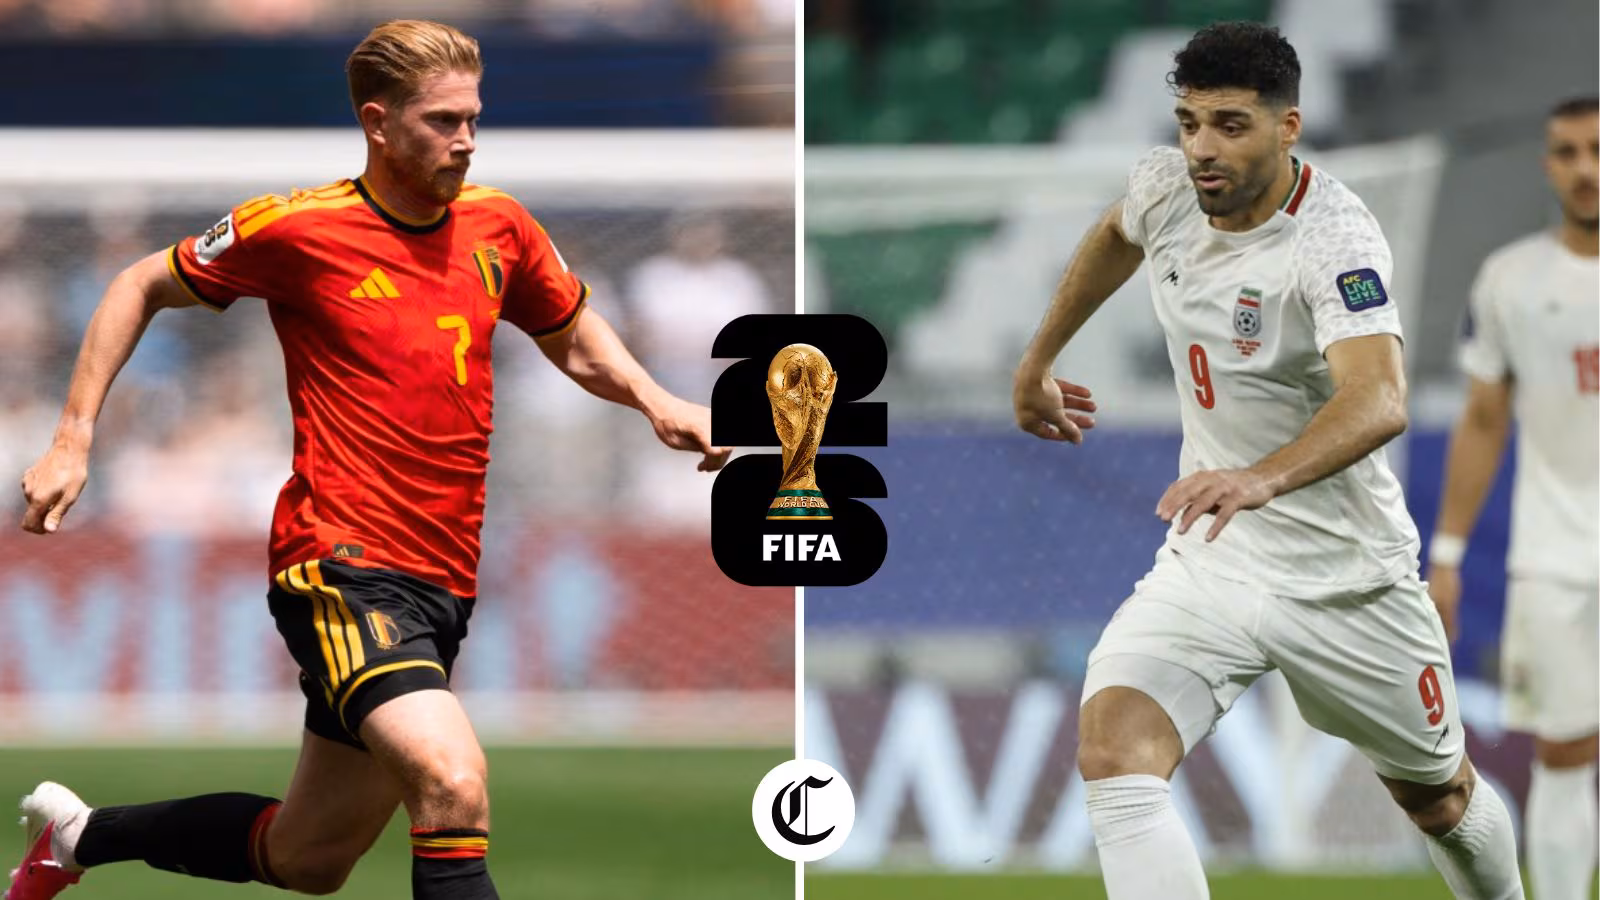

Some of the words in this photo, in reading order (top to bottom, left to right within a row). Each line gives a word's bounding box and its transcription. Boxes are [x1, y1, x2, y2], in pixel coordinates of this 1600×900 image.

[1343, 275, 1361, 286] AFC
[1345, 279, 1376, 295] LIVE
[436, 315, 472, 386] 7
[1188, 344, 1216, 410] 9
[1418, 664, 1445, 727] 9
